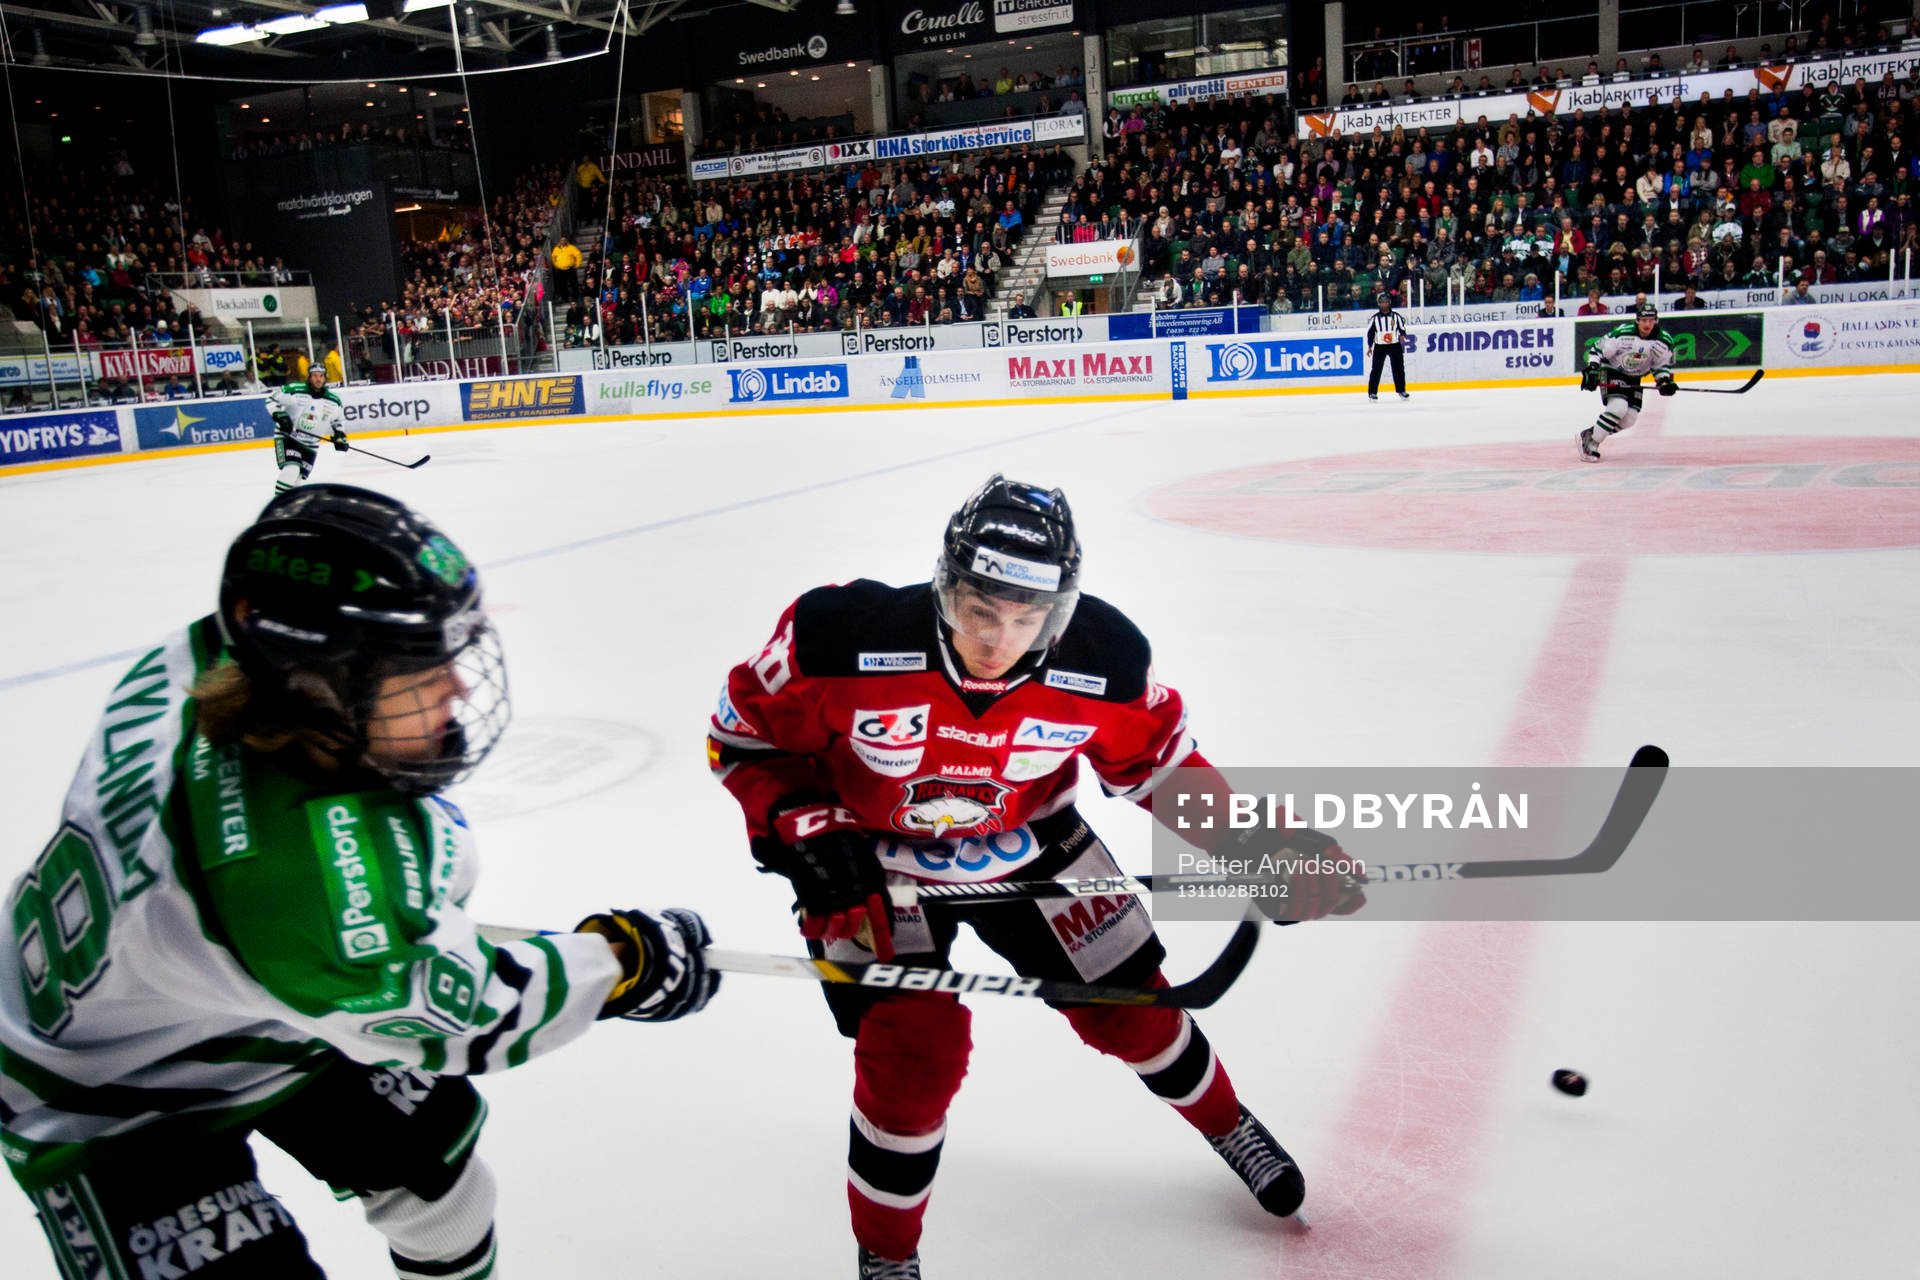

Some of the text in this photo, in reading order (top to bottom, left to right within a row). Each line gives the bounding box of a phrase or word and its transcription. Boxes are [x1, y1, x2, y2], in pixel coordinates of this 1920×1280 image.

[901, 1, 985, 35] Cernelle
[923, 31, 966, 45] SWEDEN
[739, 44, 806, 66] Swedbank
[1800, 64, 1839, 86] jkab
[1168, 75, 1284, 98] olivetti CENTER
[1568, 83, 1689, 110] jkab ARKITEKTER
[1036, 119, 1075, 133] FLORA
[1342, 108, 1452, 132] jkab ARKITEKTER
[876, 128, 1032, 158] HNA Storköksservice
[1050, 252, 1115, 268] Swedbank
[1820, 293, 1845, 304] DIN
[1007, 324, 1083, 344] Perstorp
[1841, 319, 1902, 332] HALLANDS
[734, 342, 798, 360] Perstorp
[865, 333, 935, 352] Perstorp
[613, 349, 672, 368] Perstorp
[1008, 351, 1153, 380] MAXI MAXI
[1265, 346, 1354, 373] Lindab
[1505, 352, 1554, 369] ESLÖV
[773, 370, 841, 394] Lindab
[879, 372, 981, 387] ÄNGELHOLMSHEM
[1022, 377, 1076, 387] STORMARKNAD
[1096, 373, 1153, 384] STORMARKNAD
[600, 379, 713, 401] kullaflyg.se
[519, 407, 571, 418] TRANSPORT
[191, 423, 255, 443] bravida
[247, 545, 333, 586] akea
[963, 680, 1006, 692] Reebok
[858, 712, 924, 744] G4S
[936, 725, 1009, 748] stadium
[941, 764, 992, 777] MALMÖ
[327, 804, 376, 925] Perstorp
